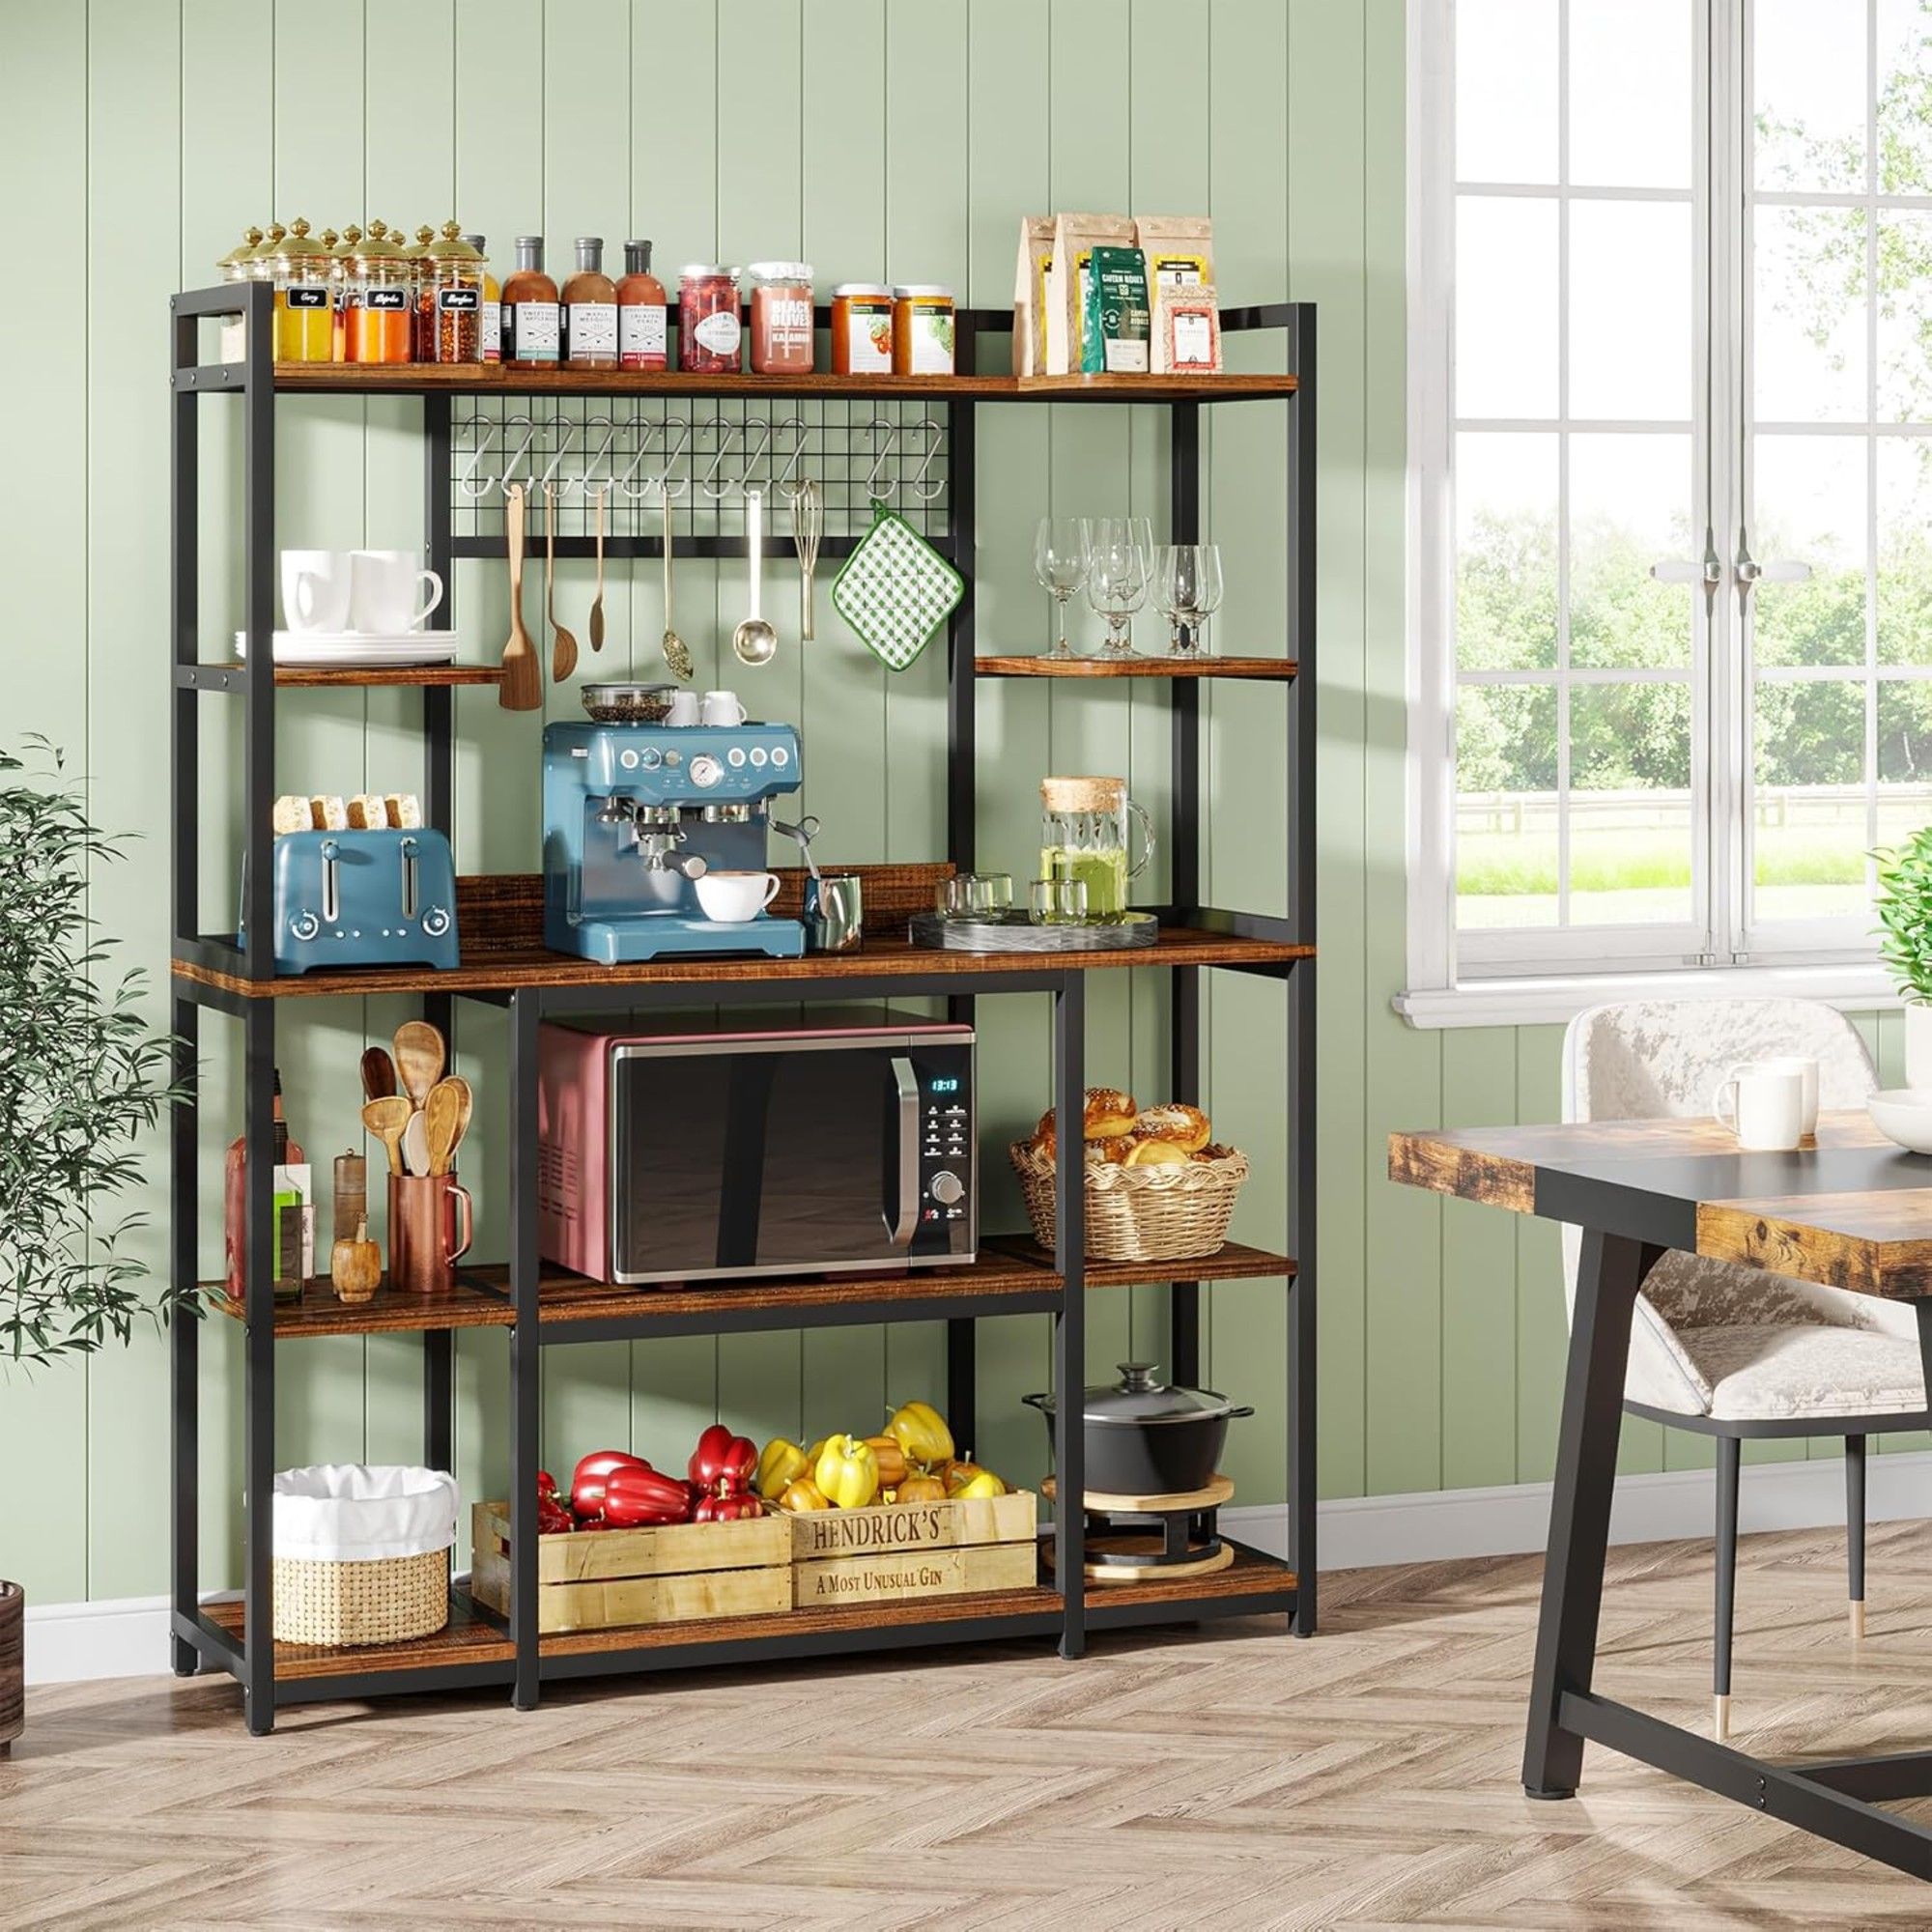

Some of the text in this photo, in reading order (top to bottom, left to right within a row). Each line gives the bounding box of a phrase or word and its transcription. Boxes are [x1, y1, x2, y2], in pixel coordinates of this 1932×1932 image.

[932, 1079, 957, 1091] 13:13
[813, 1509, 940, 1549] HENDRICK'S
[816, 1576, 825, 1594] A
